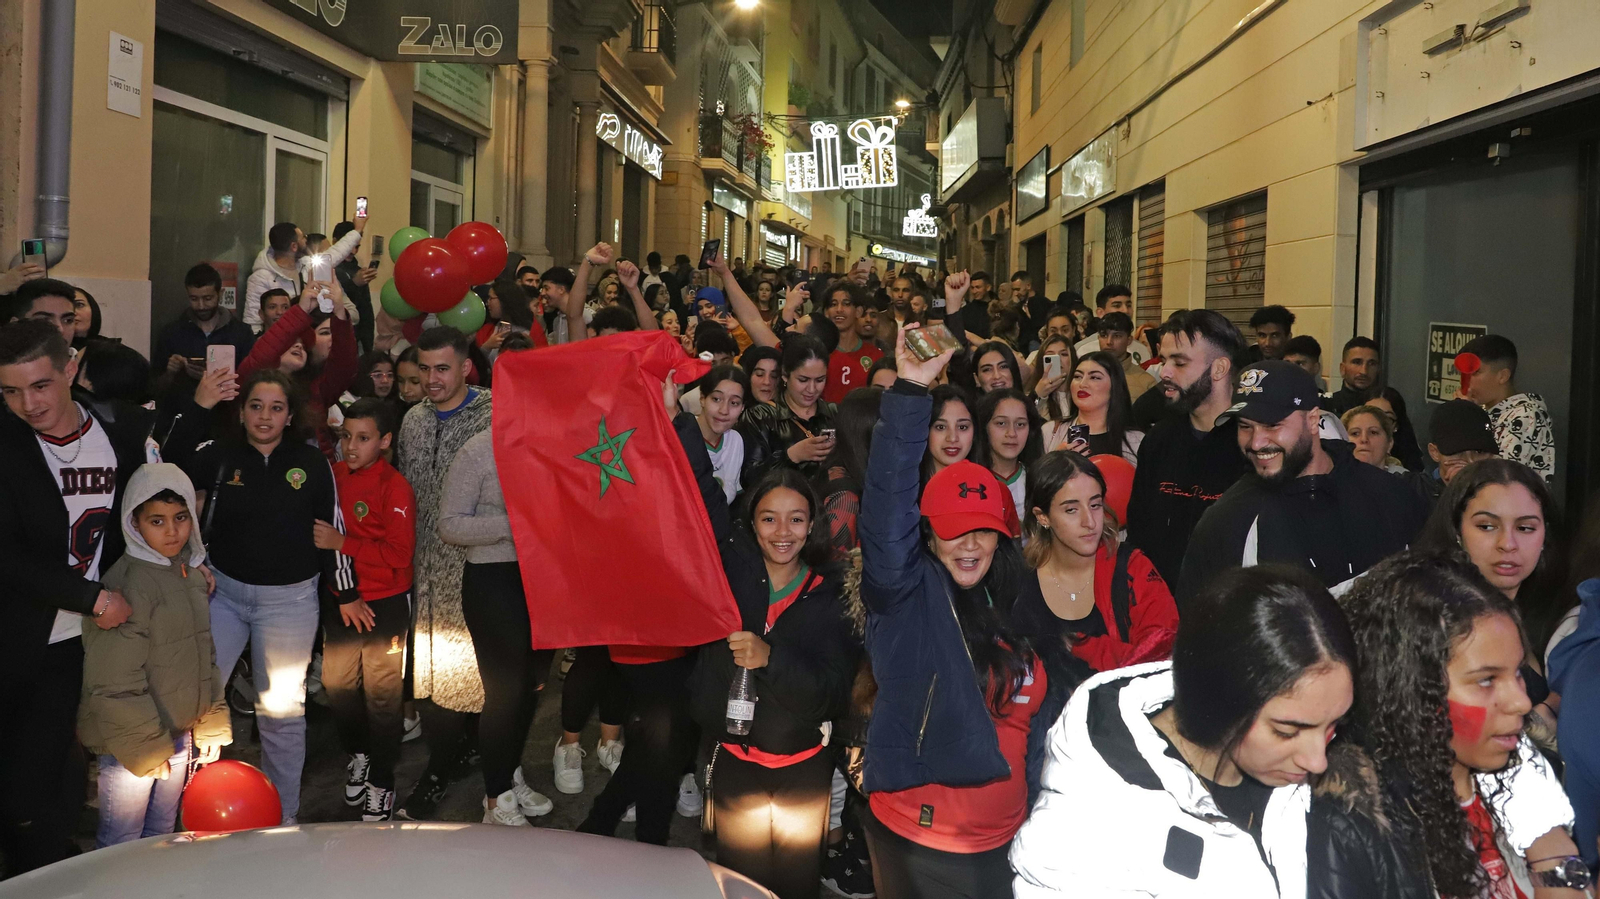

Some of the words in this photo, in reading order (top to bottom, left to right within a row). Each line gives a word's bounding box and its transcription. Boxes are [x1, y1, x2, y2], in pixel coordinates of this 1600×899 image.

[398, 16, 503, 56] ZALO
[1431, 330, 1444, 353] SE
[842, 366, 850, 385] 2
